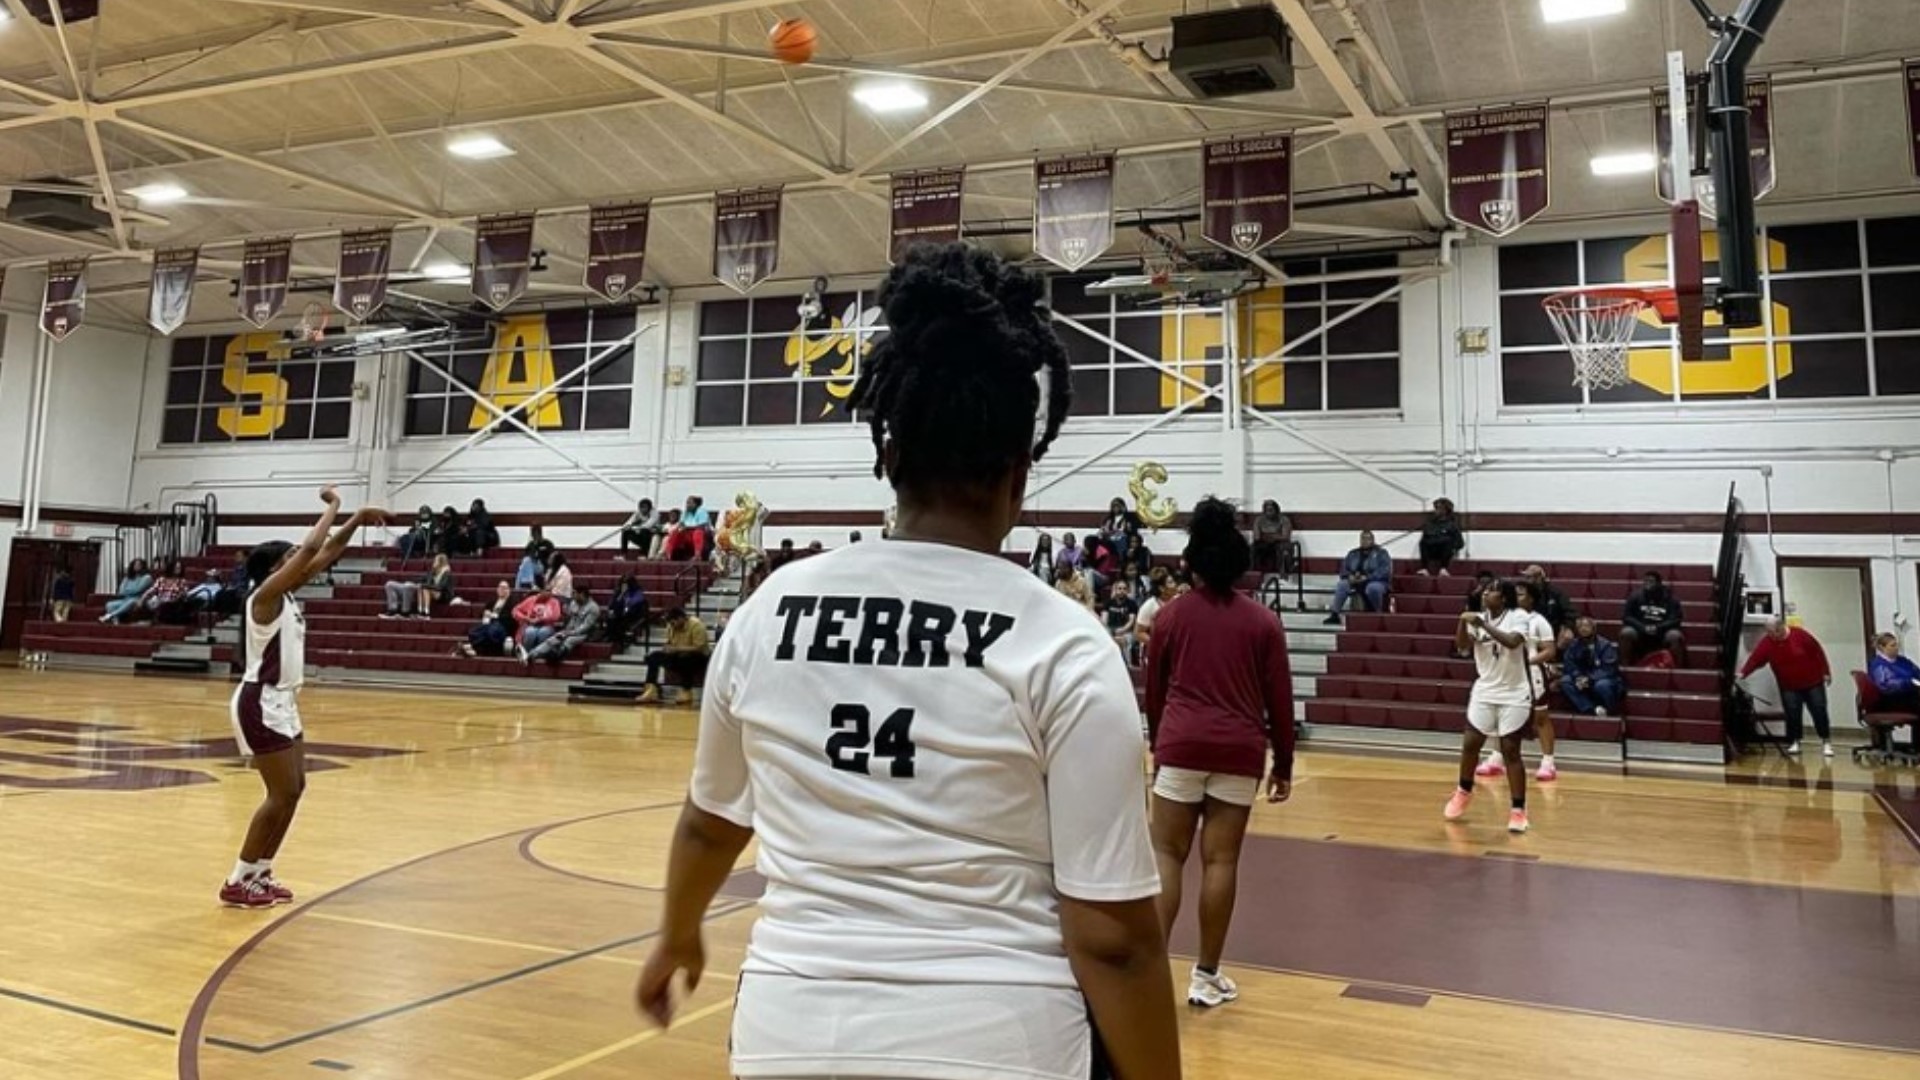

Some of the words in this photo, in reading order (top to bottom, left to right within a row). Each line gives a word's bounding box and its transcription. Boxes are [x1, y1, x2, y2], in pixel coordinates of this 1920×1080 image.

[1480, 109, 1544, 125] SWIMMING
[217, 329, 292, 437] S
[468, 313, 562, 429] A
[775, 595, 1015, 667] TERRY
[825, 703, 915, 778] 24
